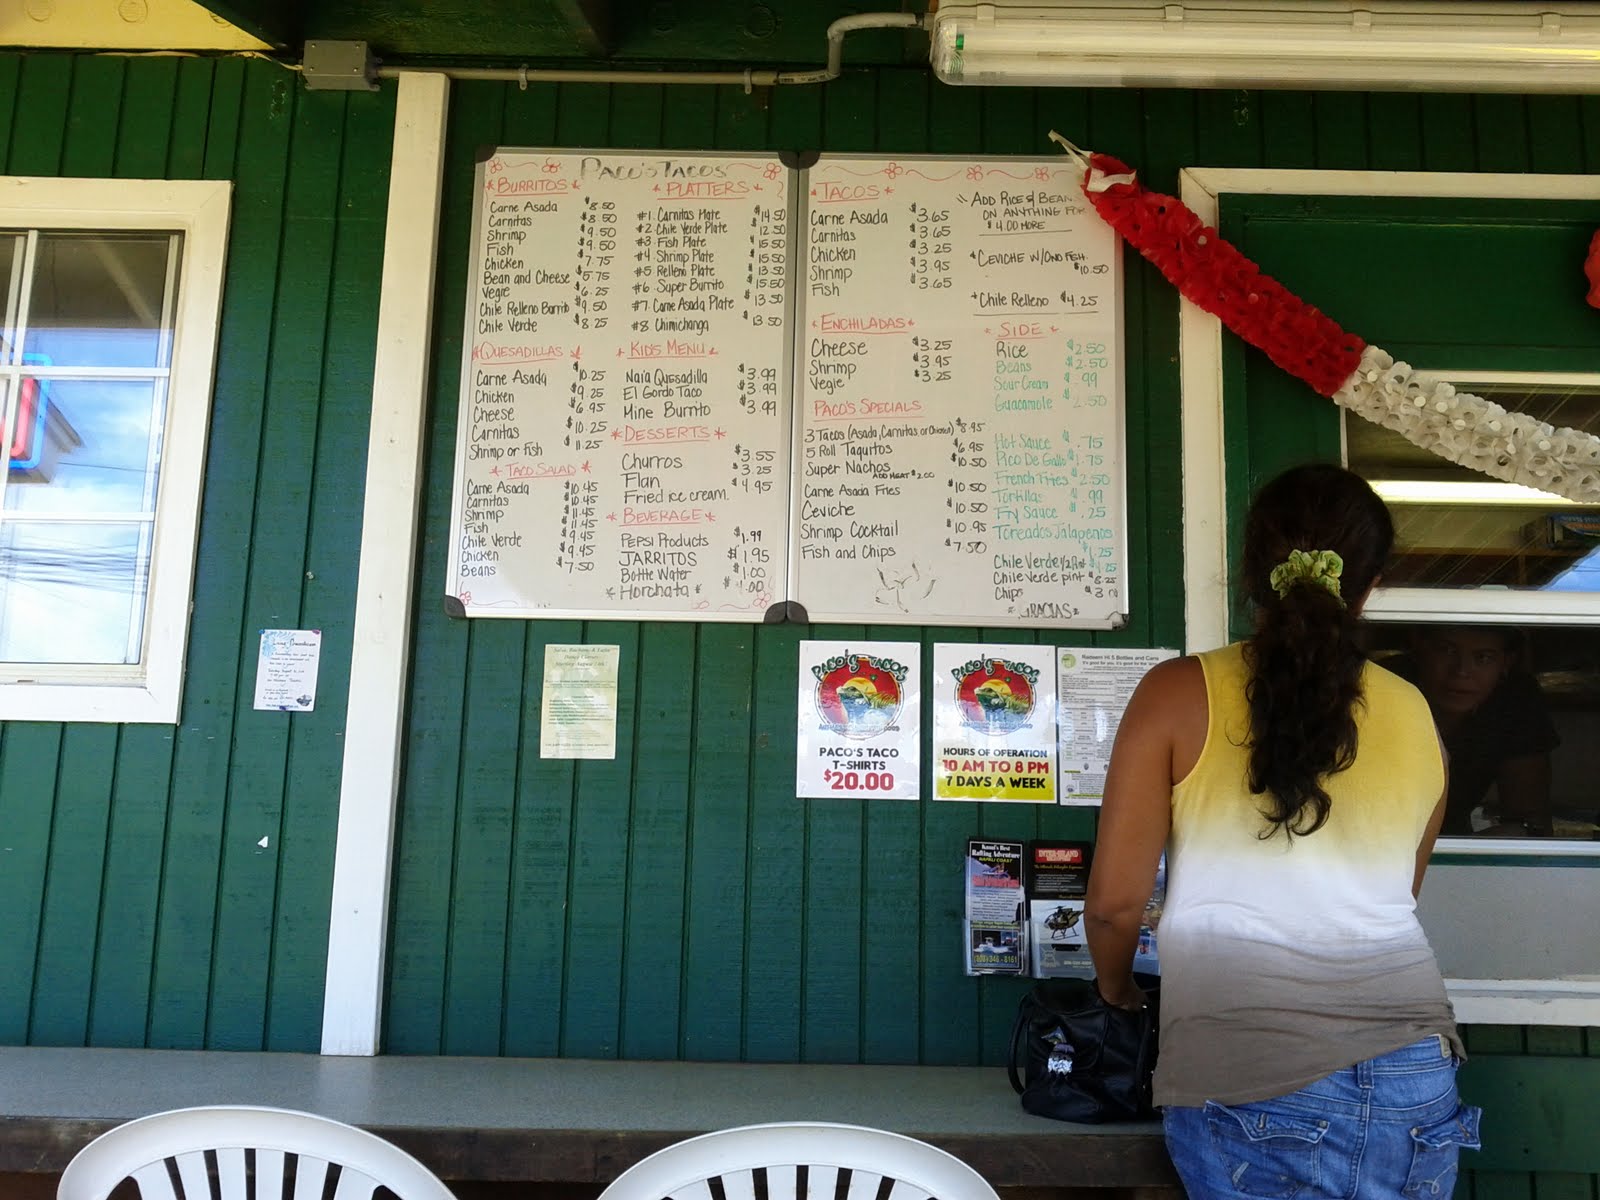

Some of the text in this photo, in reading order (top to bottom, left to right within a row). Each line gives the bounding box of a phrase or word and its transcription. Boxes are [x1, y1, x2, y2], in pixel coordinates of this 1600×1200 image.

[498, 177, 567, 193] BURRITOS
[667, 181, 750, 196] PLATTERS
[816, 181, 880, 200] TACOS
[490, 201, 558, 213] Carne Asada
[658, 207, 694, 221] Carnitas
[983, 209, 997, 220] ON
[1004, 208, 1060, 218] ANYTHING
[489, 215, 532, 227] Carnitas
[811, 209, 888, 225] Carne Asada
[656, 222, 728, 235] Chile Verde Plate
[1020, 221, 1045, 230] MORE
[487, 230, 526, 244] Shrimp
[658, 236, 706, 248] Fish Plate
[811, 228, 856, 244] Carnitas
[487, 242, 513, 256] Fish
[811, 246, 855, 263] Chicken
[485, 257, 524, 270] Chicken
[657, 249, 714, 269] Shrimp Plate
[484, 270, 570, 285] Bean and Cheese
[657, 264, 715, 277] Relleno Plate
[810, 265, 852, 283] Shrimp
[656, 278, 724, 296] Super Burrito
[812, 283, 839, 296] Fish
[653, 295, 734, 313] Carne Asada Plate
[980, 292, 1008, 308] Chile
[1012, 292, 1049, 306] Relleno
[480, 302, 538, 317] Chile Relleno
[479, 318, 537, 334] Chile Verde
[655, 318, 709, 335] Chimichanga
[821, 312, 906, 330] ENCHILADAS
[480, 342, 563, 360] QUESADILLAS
[667, 339, 704, 355] MENU
[811, 338, 868, 358] Cheese
[997, 341, 1028, 358] Rice
[809, 360, 856, 379] Shrimp
[996, 360, 1032, 374] Beans
[477, 369, 547, 386] Carne Asada
[994, 375, 1048, 391] Sour Cream
[475, 389, 514, 404] Chicken
[643, 385, 673, 399] Gordo
[676, 385, 702, 398] Taco
[664, 401, 711, 418] Burrito
[860, 399, 922, 414] SPECIALS
[474, 406, 514, 423] Cheese
[472, 424, 519, 442] Carnitas
[625, 425, 711, 442] DESSERTS
[816, 428, 845, 441] Tacos
[1020, 433, 1052, 449] Sauce
[469, 442, 542, 460] Shrimp or Fish
[819, 445, 836, 457] Roll
[840, 441, 892, 461] Taquitos
[622, 453, 682, 470] Churros
[535, 463, 576, 476] SALAD
[806, 461, 891, 478] Super Nachos
[467, 479, 529, 496] Carne Asada
[620, 471, 660, 489] Flan
[624, 489, 663, 503] Fried
[805, 484, 834, 498] Carne
[467, 496, 509, 509] Carnitas
[802, 500, 855, 520] Ceviche
[465, 509, 504, 523] Shrimp
[623, 507, 702, 523] BEVERAGE
[1024, 506, 1058, 519] Sauce
[464, 523, 488, 534] Fish
[801, 520, 898, 542] Shrimp Cocktail
[462, 531, 522, 550] Chile Verde
[658, 532, 709, 547] Products
[462, 550, 499, 563] Chicken
[619, 552, 697, 566] JARRITOS
[801, 544, 896, 562] Fish and Chips
[994, 554, 1023, 570] Chile
[461, 565, 496, 576] Beans
[658, 567, 691, 580] Water
[993, 571, 1023, 585] Chile
[1025, 571, 1058, 582] Verde
[620, 582, 689, 600] Horchata
[995, 587, 1023, 602] Chips
[819, 747, 899, 758] PACO'S TACO
[944, 748, 975, 756] HOURS
[993, 749, 1047, 758] OPERATION
[832, 760, 886, 770] T-SHIRTS
[943, 759, 1049, 774] 10 AM TO 8 PM
[823, 769, 894, 790] $20.00
[946, 776, 1045, 788] 7 DAYS A WEEK
